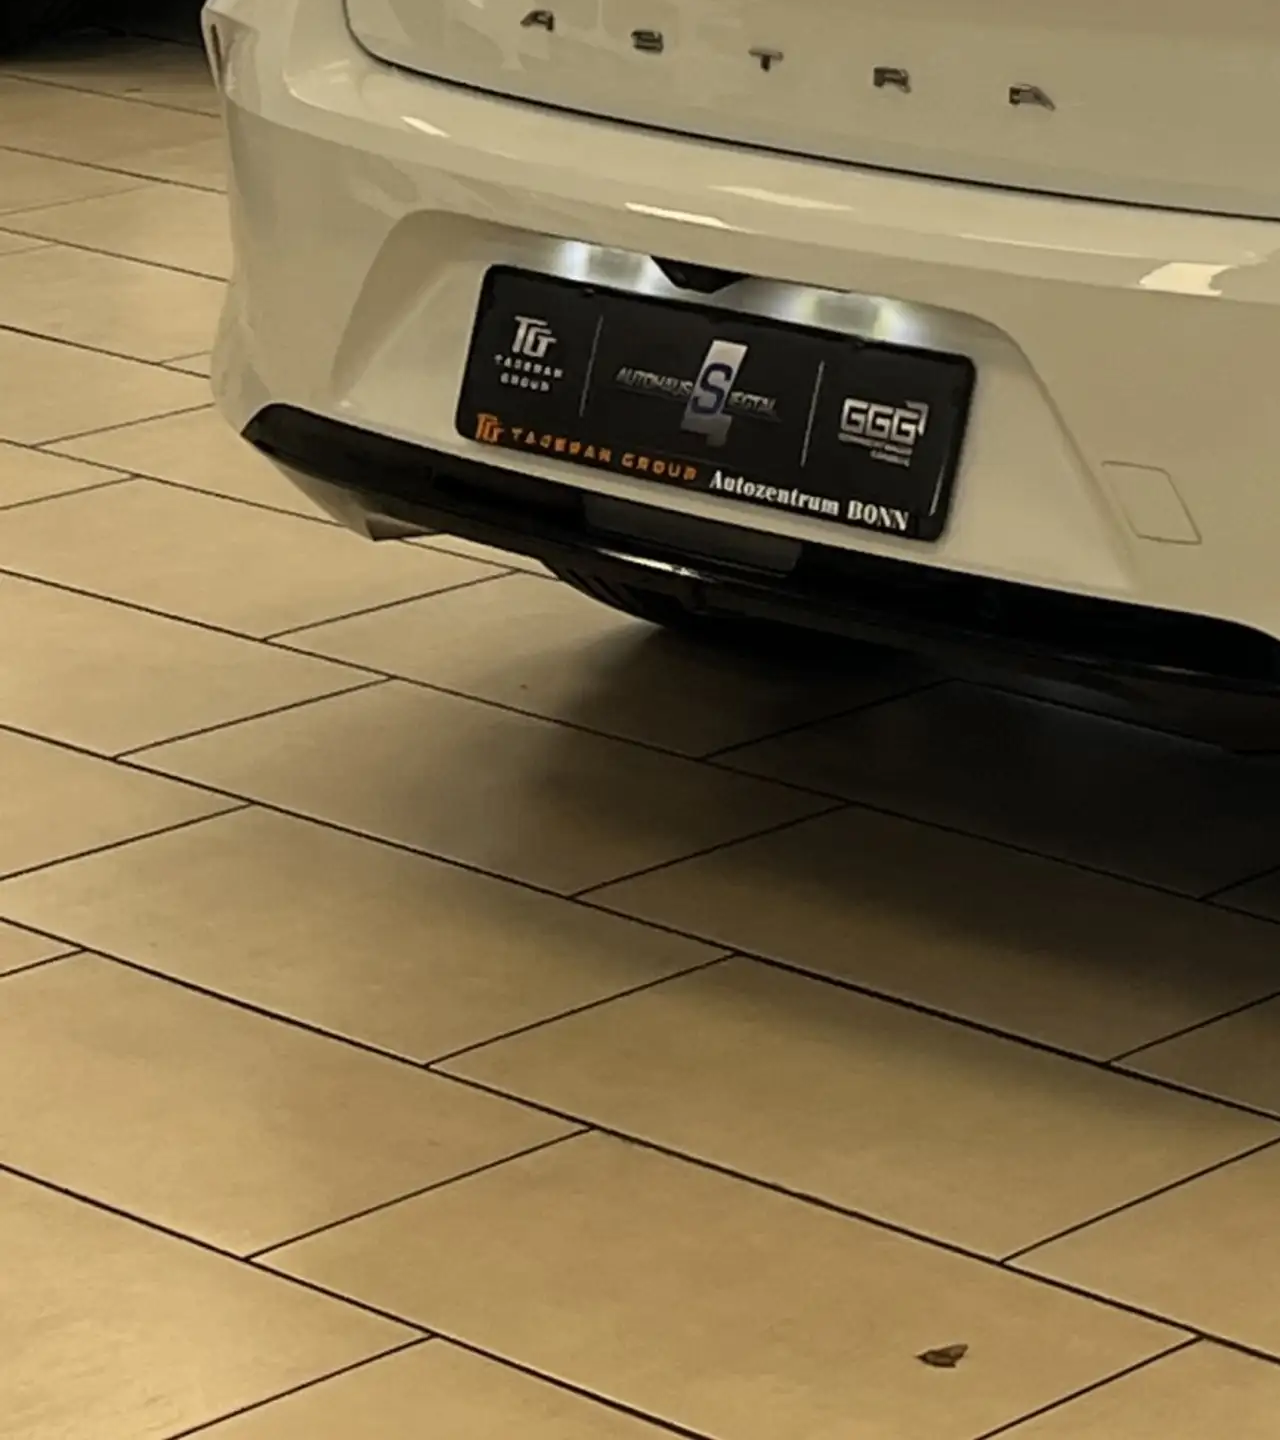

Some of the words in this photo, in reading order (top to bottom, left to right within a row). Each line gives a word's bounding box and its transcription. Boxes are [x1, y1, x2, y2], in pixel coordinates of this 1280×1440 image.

[500, 371, 550, 392] GROUP
[621, 452, 698, 481] GROUP
[709, 469, 840, 516] Autozentrum
[846, 499, 909, 532] BONN
